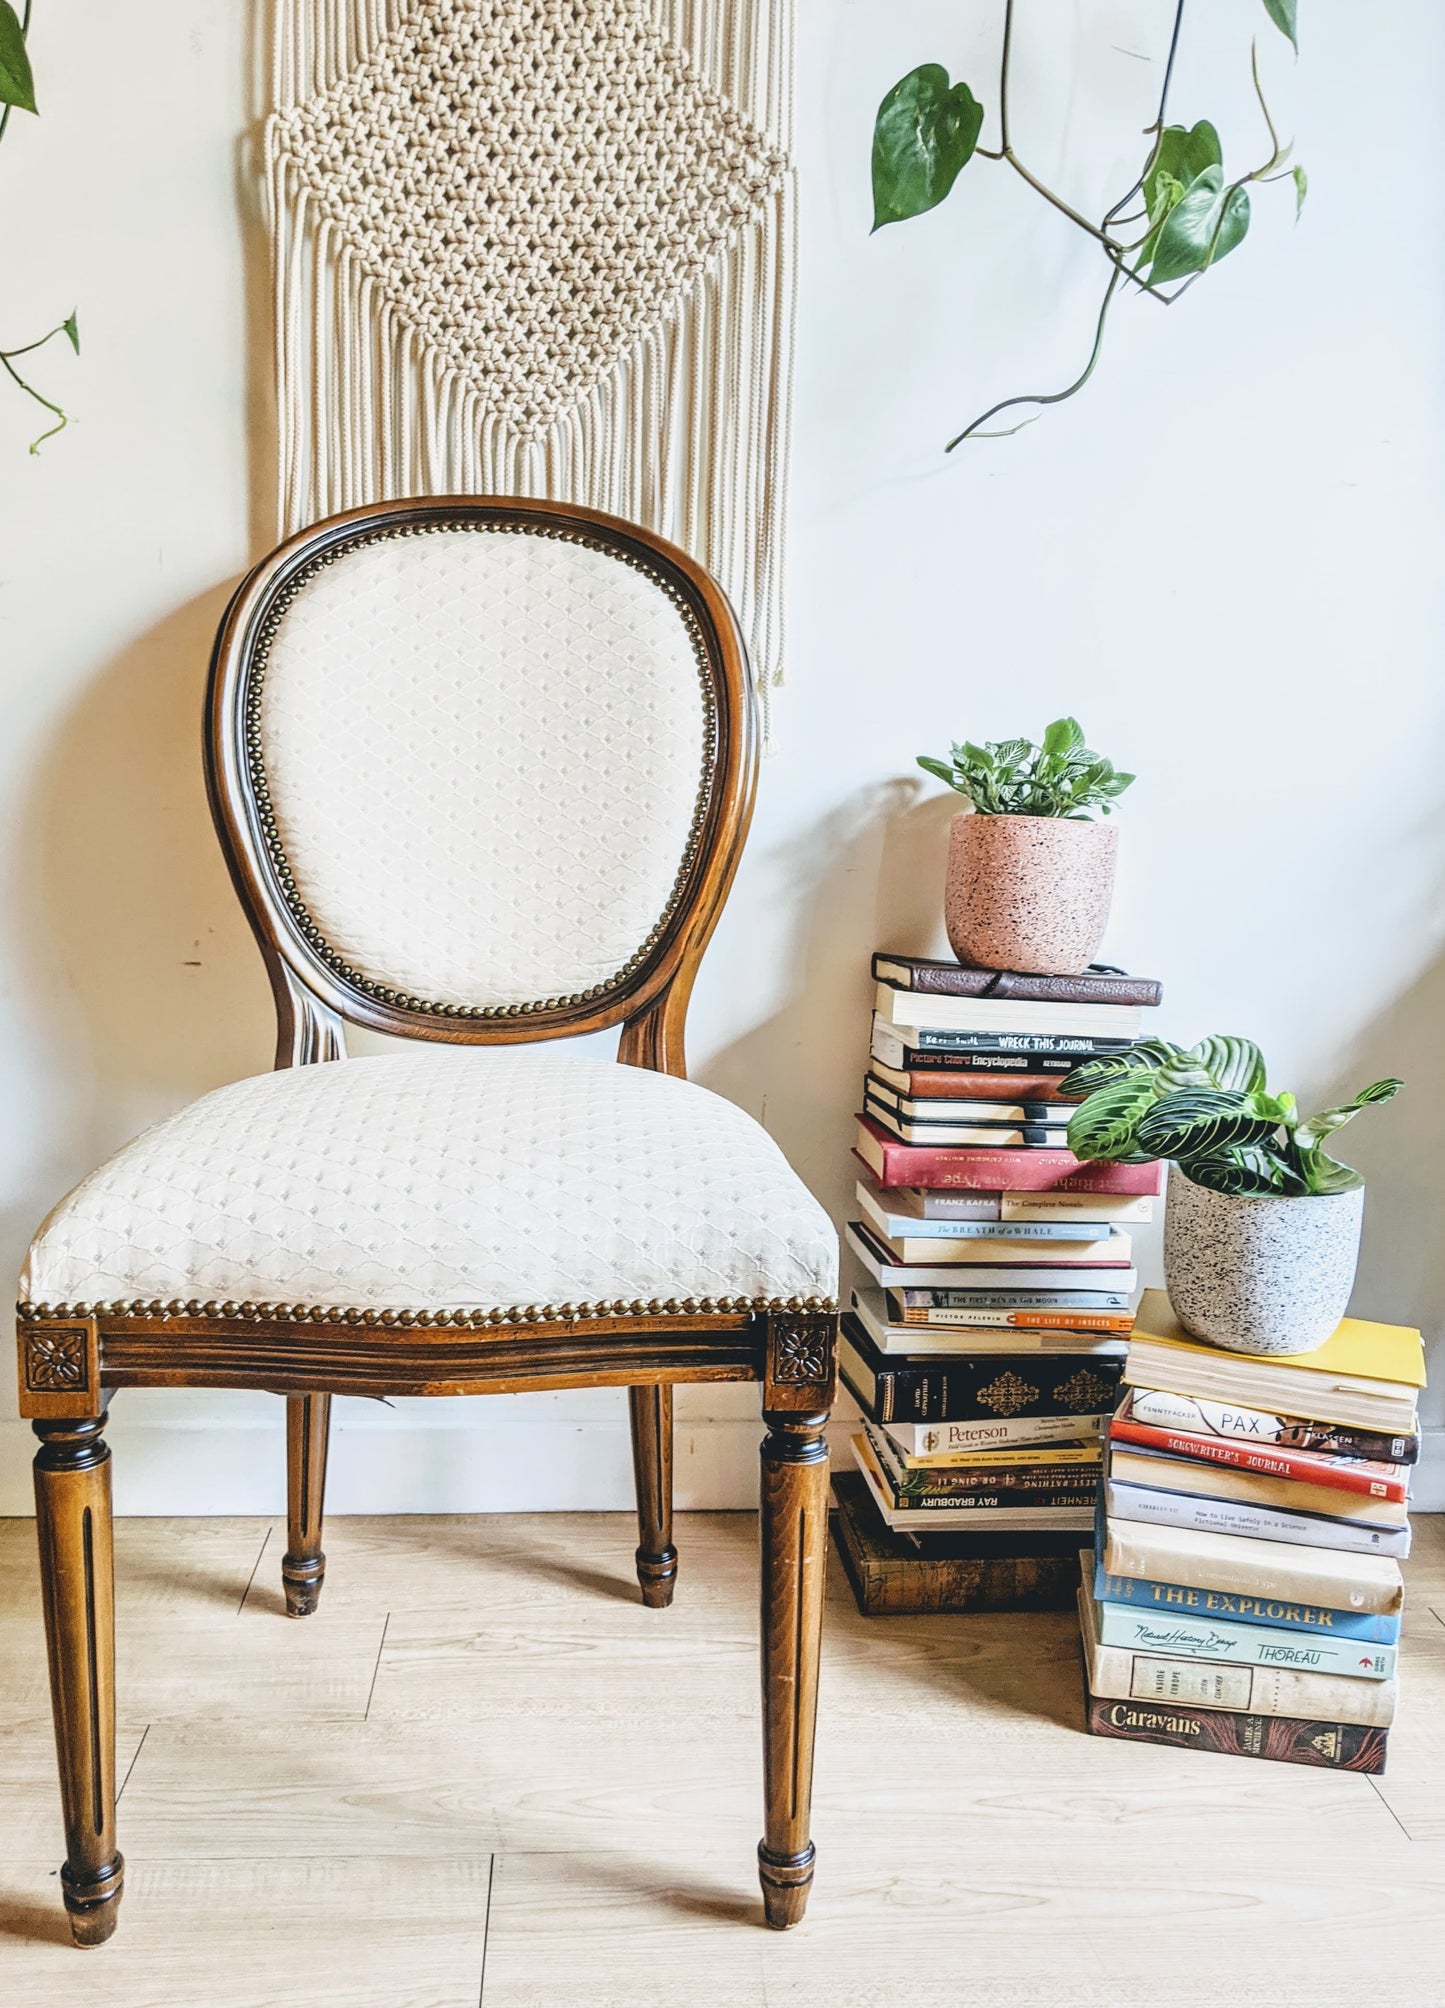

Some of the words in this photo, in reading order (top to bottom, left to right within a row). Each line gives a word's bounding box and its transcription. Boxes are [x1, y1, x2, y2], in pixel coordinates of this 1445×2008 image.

[999, 1036, 1031, 1049] WRECK
[1032, 1037, 1056, 1051] THIS
[1056, 1038, 1095, 1052] JOURNAL
[910, 1053, 942, 1064] Picture
[972, 1055, 1029, 1068] Encyclopedia
[942, 1172, 981, 1189] Type
[1053, 1177, 1094, 1192] Right
[966, 1199, 996, 1207] KAFKA
[1022, 1200, 1056, 1209] Complete
[937, 1226, 950, 1234] The
[952, 1226, 995, 1234] BREATH
[997, 1226, 1007, 1235] of
[1014, 1227, 1054, 1236] WHALE
[1044, 1317, 1061, 1325] LIFE
[1078, 1318, 1111, 1327] INSECTS
[1142, 1405, 1197, 1420] PENNYPACKER
[1221, 1413, 1261, 1434] PAX
[949, 1425, 1008, 1443] Peterson
[1311, 1430, 1353, 1445] KLASSEN
[1167, 1438, 1240, 1463] SONGWRITER'S
[1246, 1456, 1292, 1475] JOURNAL
[937, 1478, 949, 1486] LI
[951, 1476, 977, 1486] QING
[980, 1476, 997, 1485] DR.
[1023, 1480, 1069, 1488] BATHING
[1072, 1479, 1098, 1488] REST
[920, 1497, 975, 1507] BRADBURY
[977, 1497, 998, 1506] RAY
[1050, 1496, 1098, 1506] RENHEIT
[1239, 1515, 1261, 1526] Safely
[1264, 1518, 1271, 1526] in
[1281, 1521, 1308, 1531] Science
[1151, 1584, 1199, 1607] THE
[1206, 1590, 1333, 1627] EXPLORER
[1136, 1624, 1169, 1641] Natural
[1169, 1628, 1206, 1648] History
[1257, 1643, 1332, 1666] THOREAU
[1155, 1669, 1165, 1693] INSIDE
[1170, 1671, 1180, 1695] EUROPE
[1110, 1704, 1200, 1736] Caravans
[1243, 1726, 1254, 1751] JAMES
